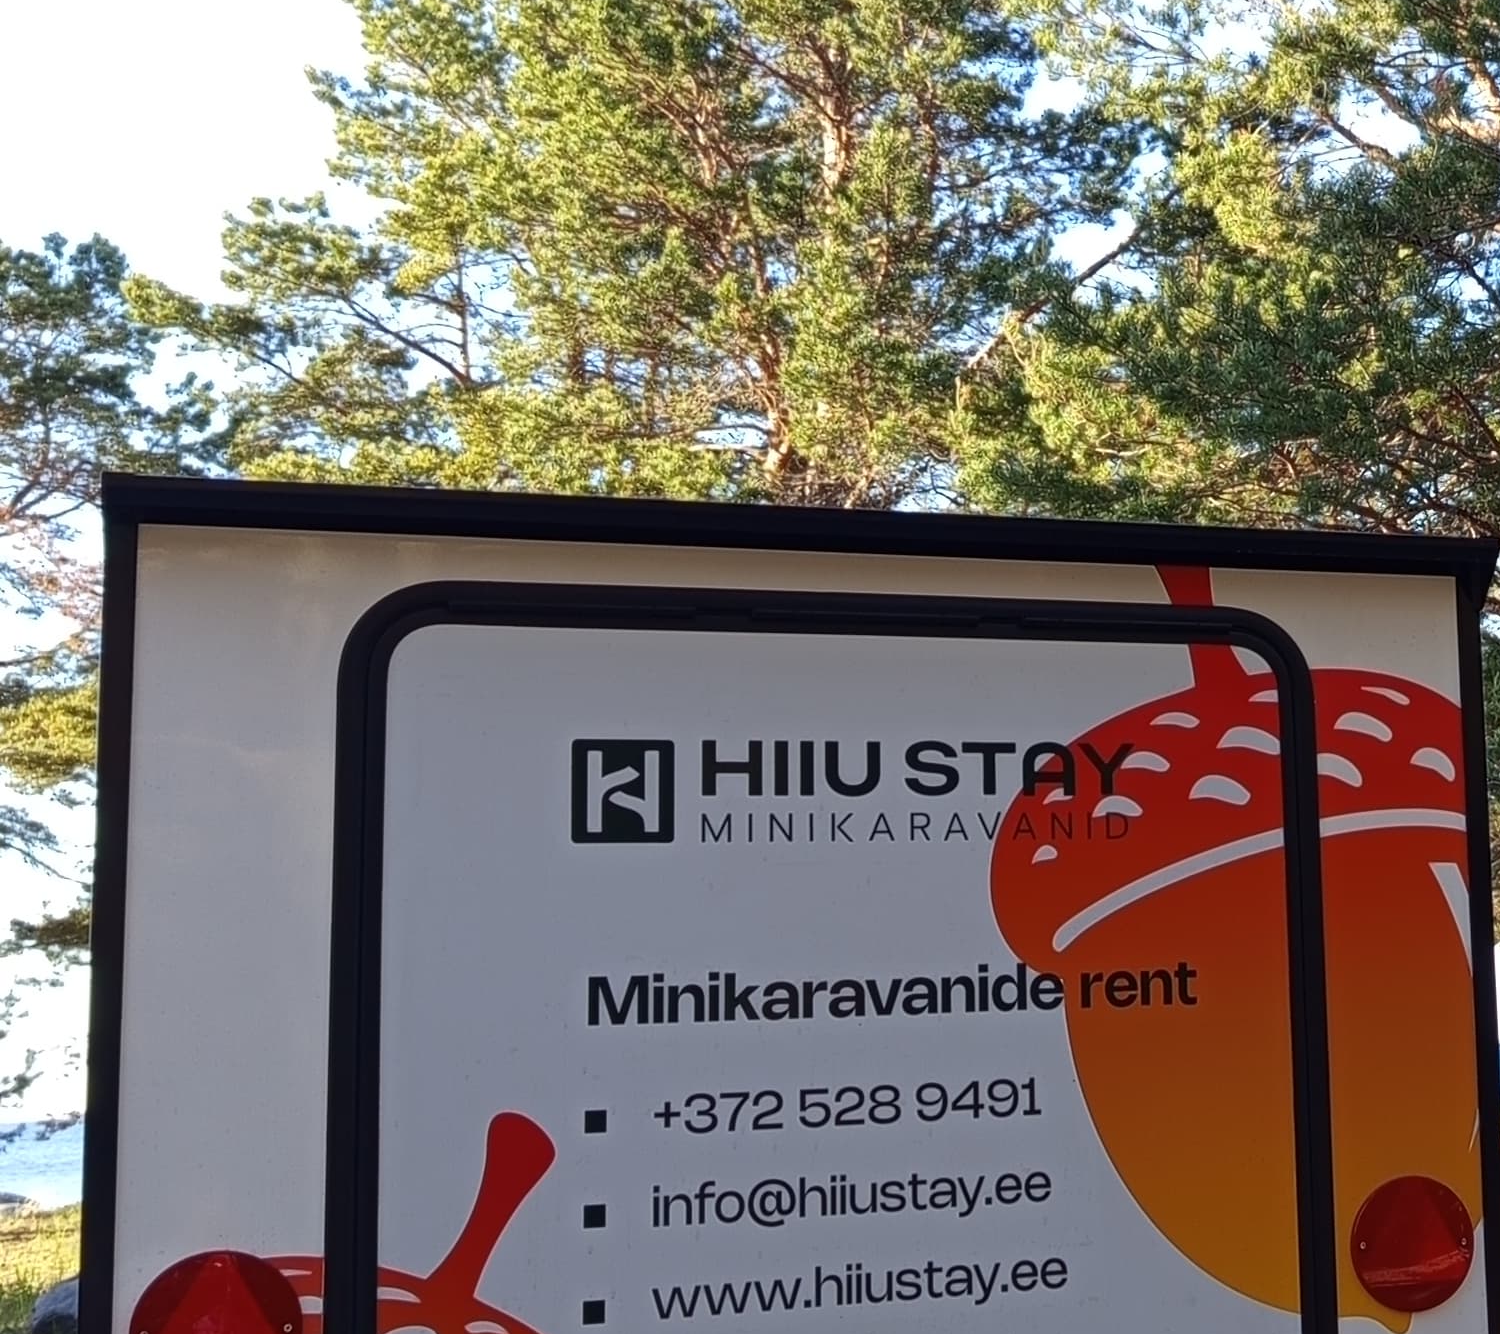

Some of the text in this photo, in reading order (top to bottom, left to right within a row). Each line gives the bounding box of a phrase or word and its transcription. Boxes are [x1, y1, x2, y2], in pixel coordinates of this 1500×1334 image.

[700, 740, 1135, 798] HIIU STAY
[700, 810, 1130, 844] MINIKARAVANID
[586, 962, 1198, 1026] Minikaravanide rent
[653, 1077, 1042, 1134] +372 528 9491
[652, 1170, 1052, 1228] info@hiiustay.ee
[652, 1256, 1069, 1320] www.hiiustay.ee
